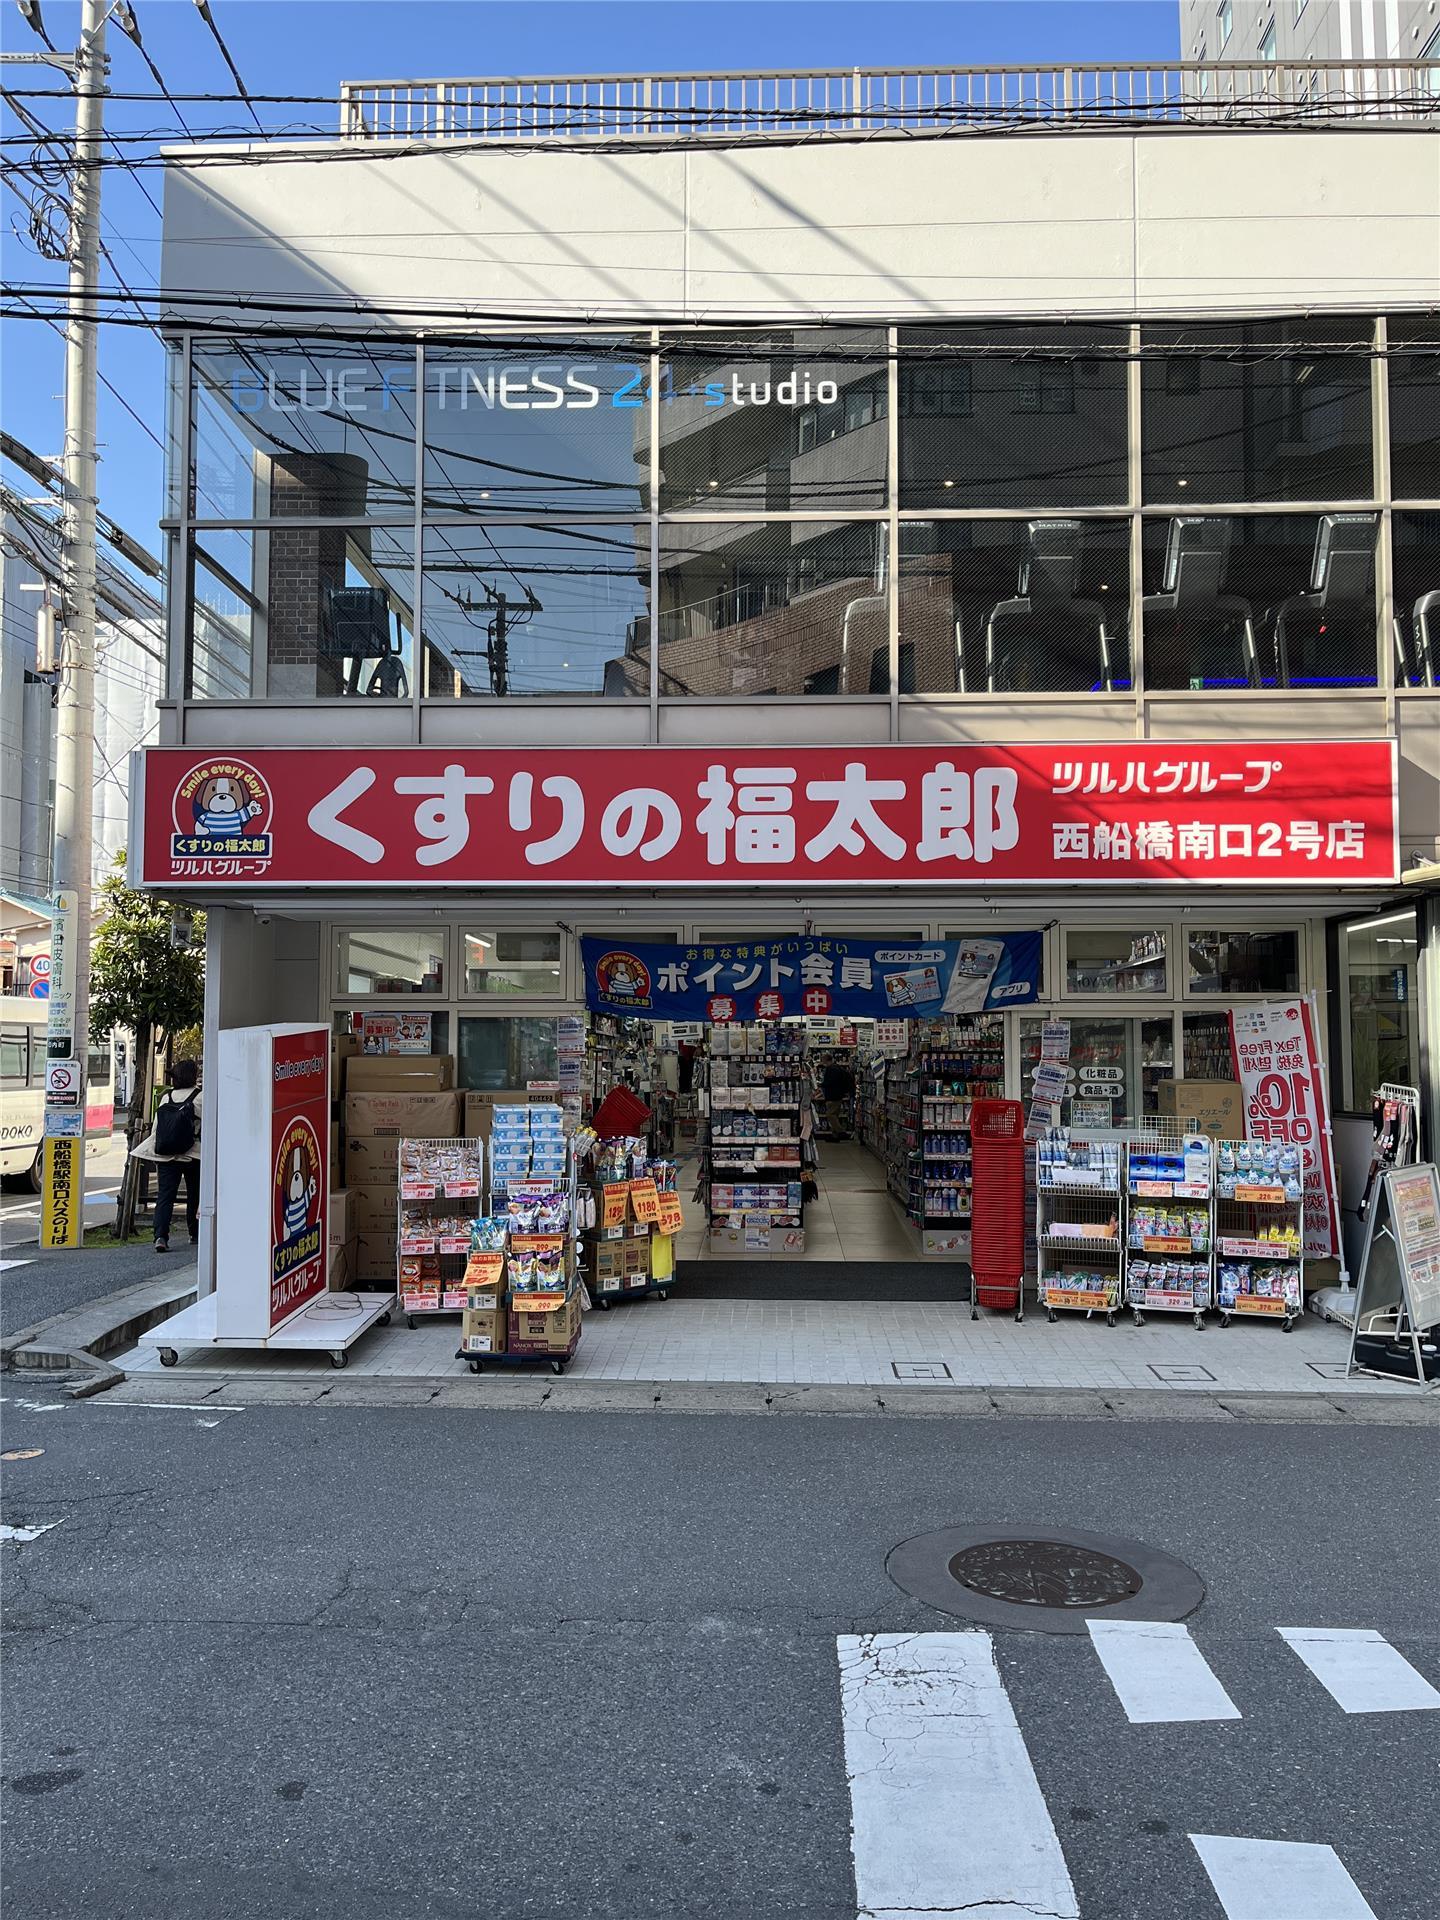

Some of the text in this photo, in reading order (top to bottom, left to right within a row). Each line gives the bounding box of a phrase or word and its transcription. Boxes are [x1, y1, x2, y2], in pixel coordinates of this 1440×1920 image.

[231, 367, 368, 412] BLUE
[382, 366, 600, 411] FTNESS
[181, 768, 210, 799] Smile
[210, 764, 245, 780] every
[1051, 760, 1283, 795] ツルハグループ
[307, 762, 1021, 867] くすりの福太郎
[175, 838, 266, 853] くすりの福太郎
[1051, 820, 1366, 861] 西船橋南口2号店
[170, 860, 272, 876] ツルハグループ
[686, 940, 848, 961] お得な特典がいっぱい
[880, 951, 941, 961] ポイントカード
[36, 960, 50, 971] 40
[656, 952, 874, 993] ポイント会員
[1000, 984, 1024, 996] アプリ
[709, 990, 828, 1020] 募集中
[1086, 1068, 1119, 1079] 化粧品
[1083, 1084, 1120, 1096] 食品・酒
[1198, 1108, 1231, 1116] エリエール
[51, 1139, 73, 1245] 西船橋駅南口バスのりば
[637, 1201, 656, 1213] 1180
[274, 1229, 319, 1273] くすりの福太郎
[272, 1259, 322, 1313] ツルハグループ
